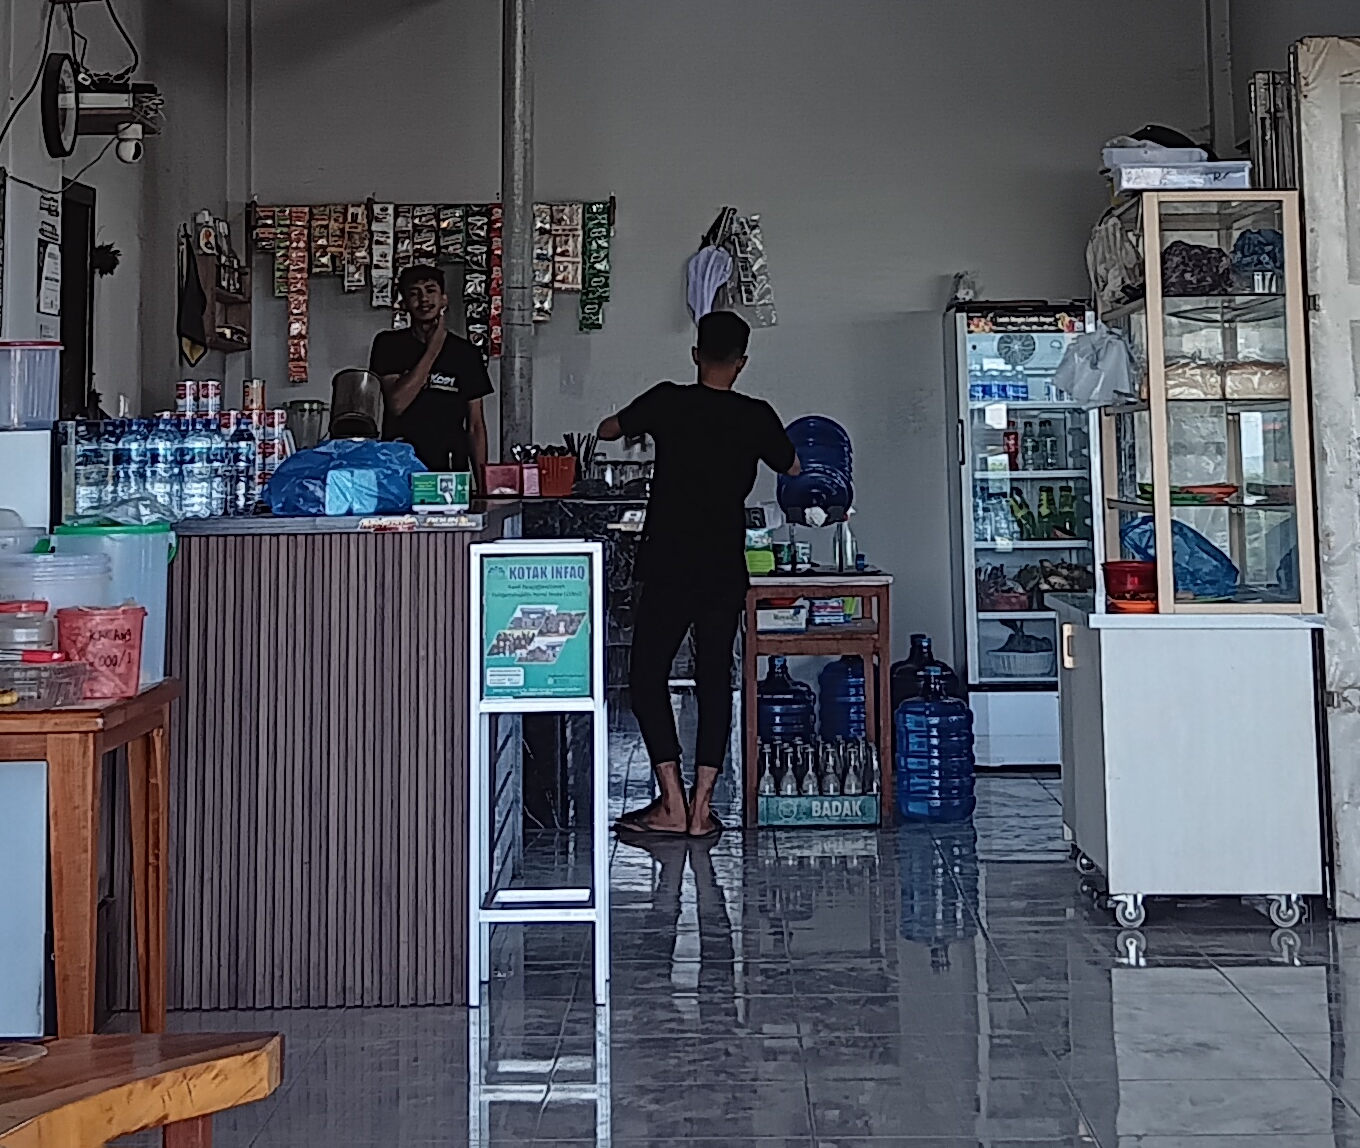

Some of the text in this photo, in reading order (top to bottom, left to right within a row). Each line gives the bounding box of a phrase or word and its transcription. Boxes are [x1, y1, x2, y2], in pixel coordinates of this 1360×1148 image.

[508, 565, 586, 581] KOTAK INFAQ
[811, 799, 863, 818] BADAK
